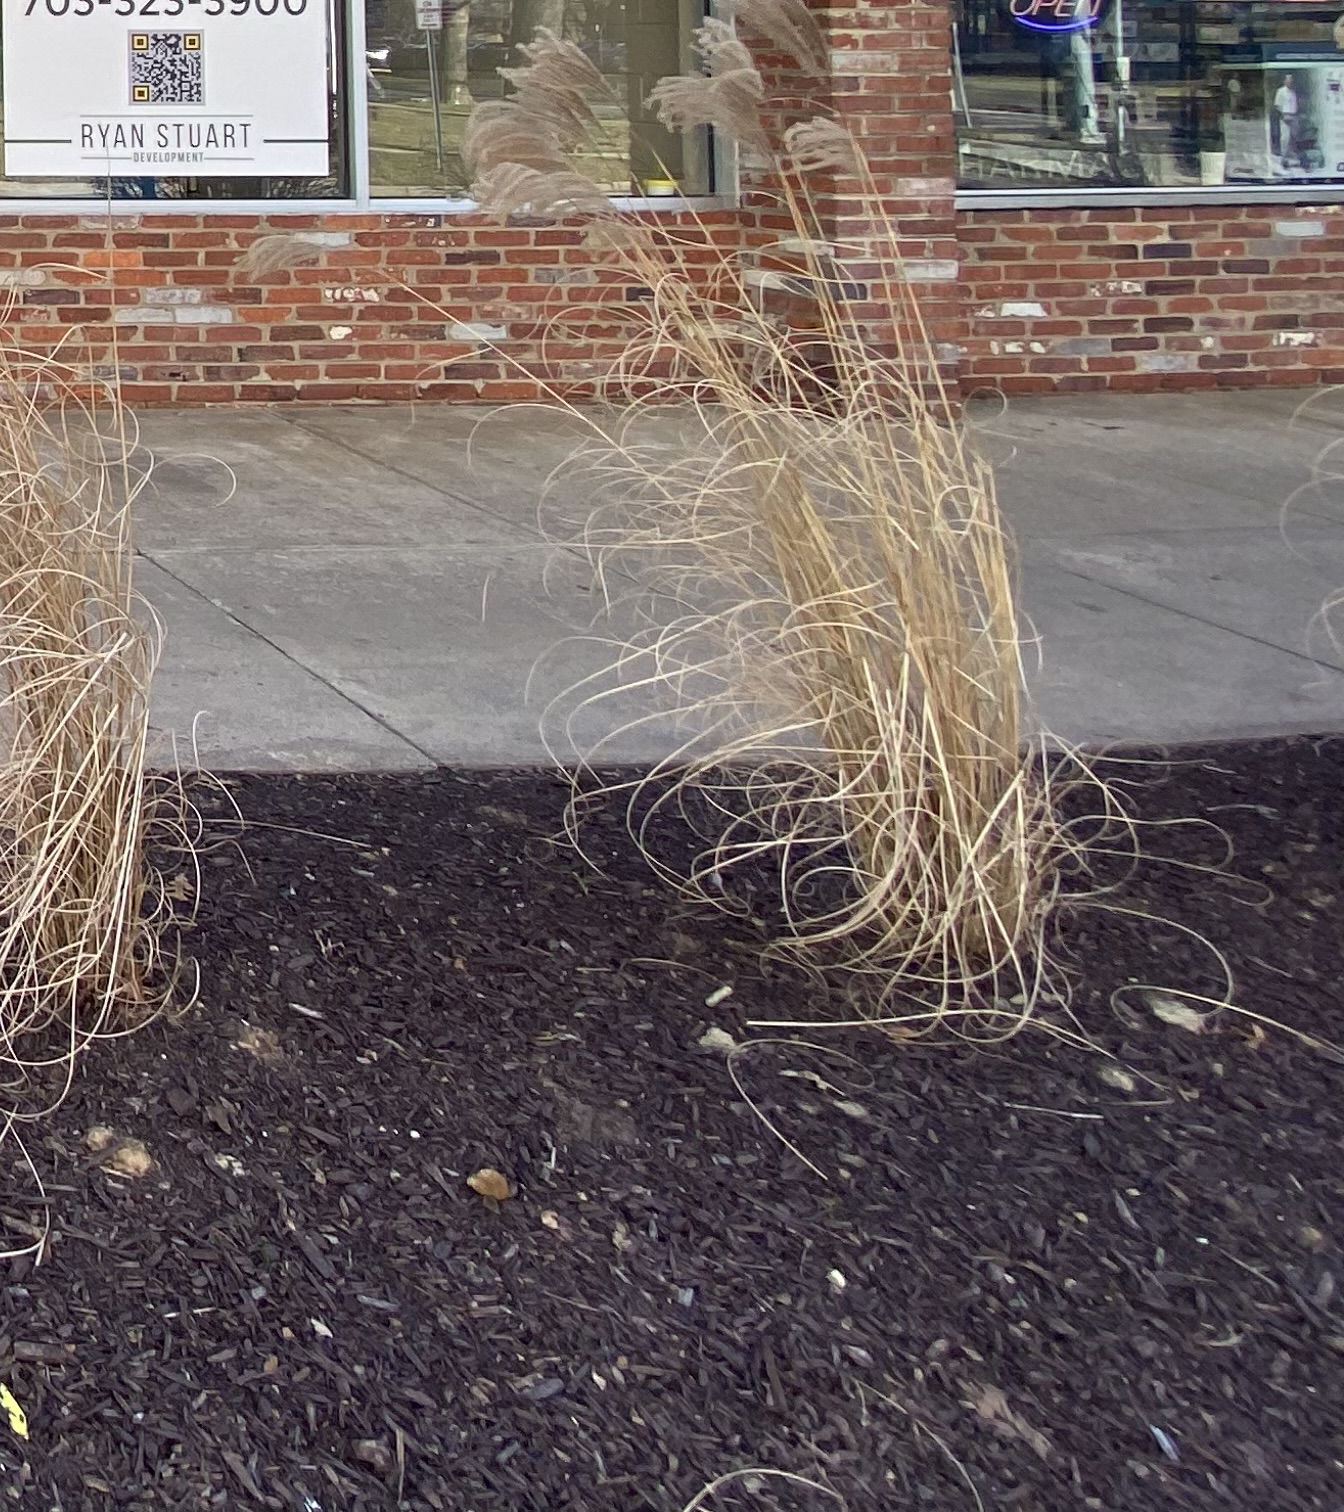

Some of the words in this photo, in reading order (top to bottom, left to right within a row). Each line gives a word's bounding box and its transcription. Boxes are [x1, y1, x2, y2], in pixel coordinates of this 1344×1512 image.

[80, 123, 145, 150] RYAN
[156, 122, 253, 149] STUART
[133, 152, 205, 163] DEVELOPMENT
